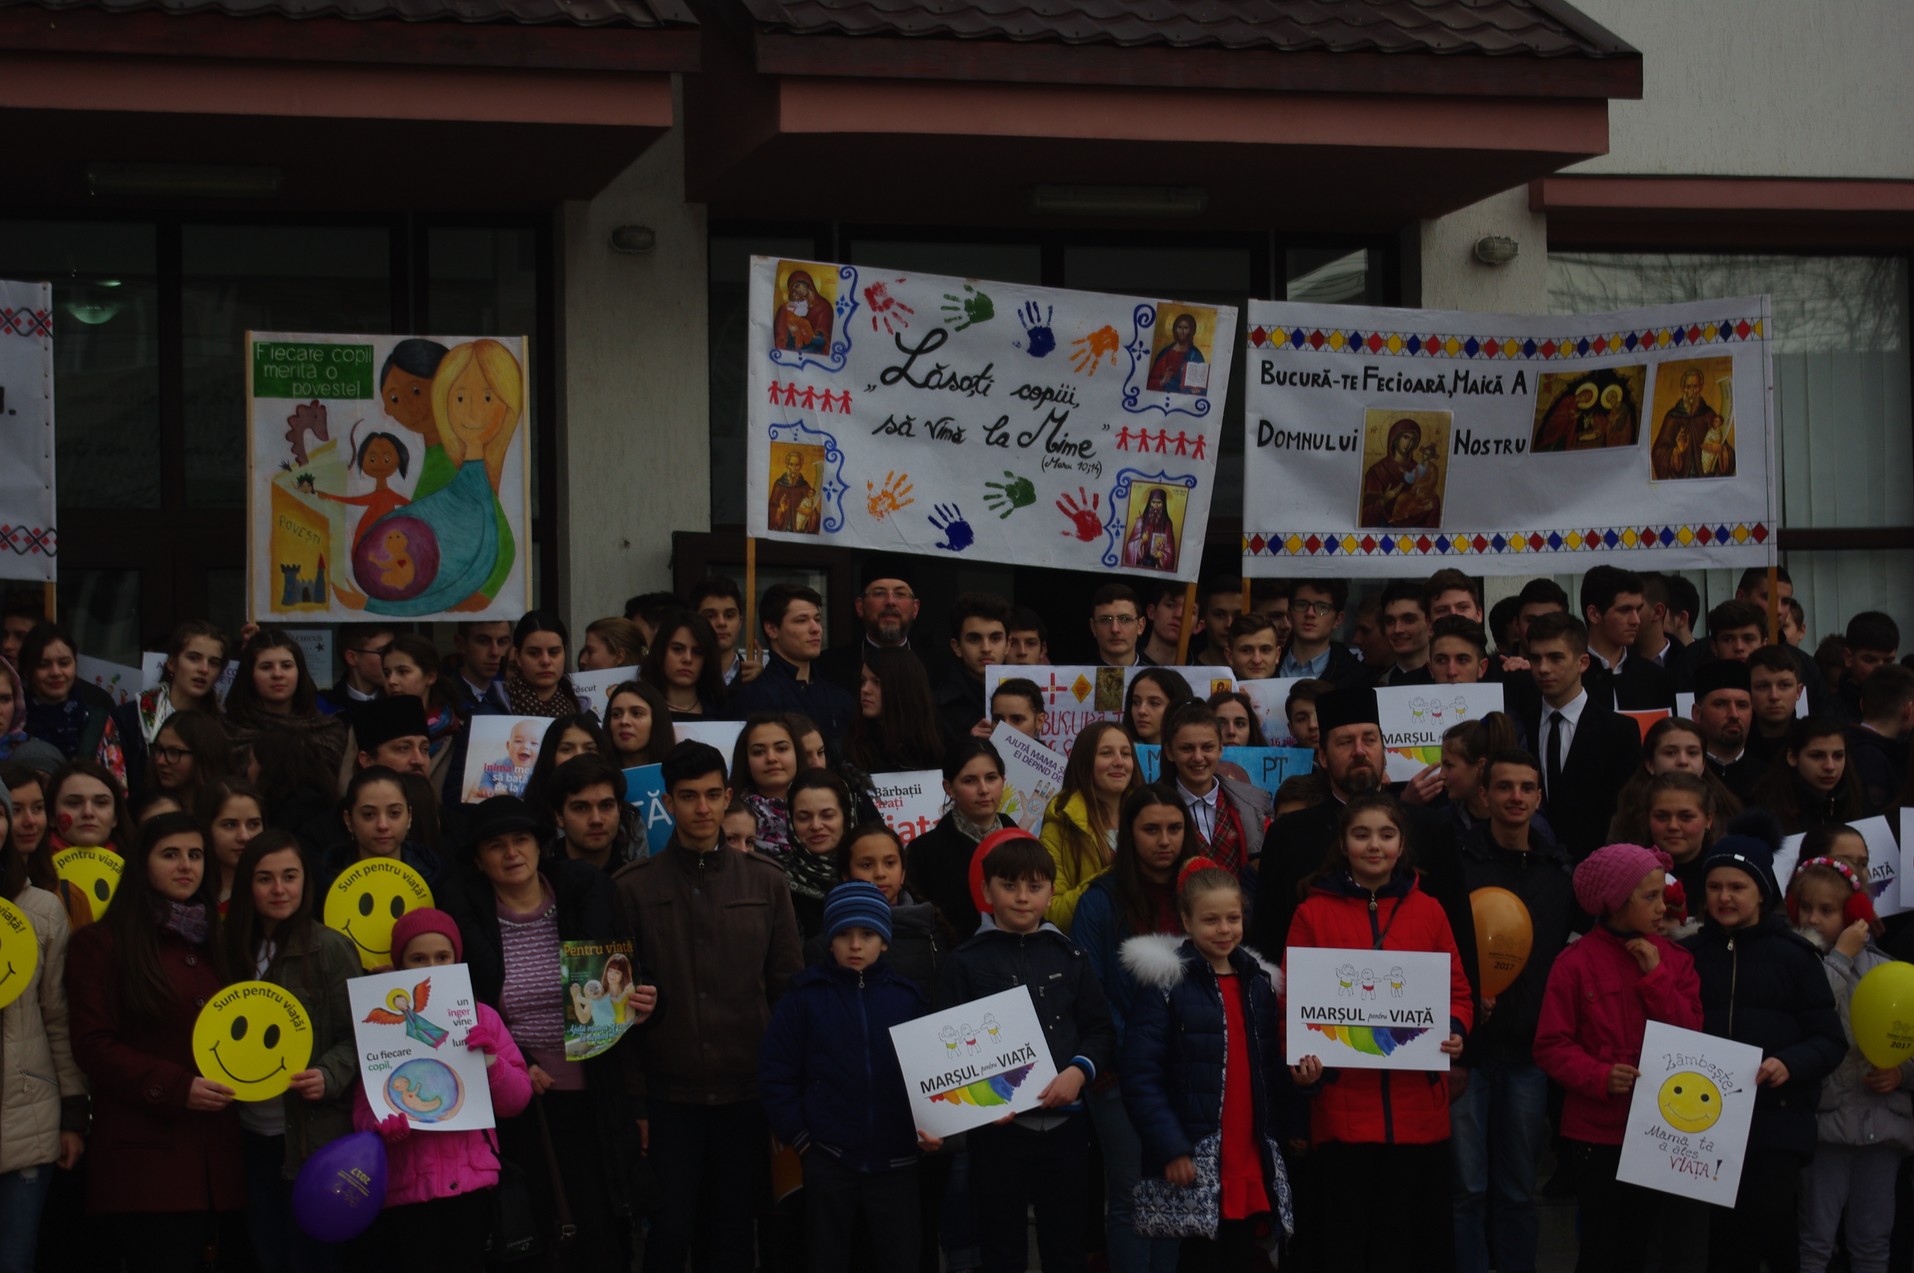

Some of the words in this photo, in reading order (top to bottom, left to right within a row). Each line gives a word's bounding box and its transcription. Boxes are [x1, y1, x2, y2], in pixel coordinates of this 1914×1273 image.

[256, 342, 324, 362] Fiecare
[326, 366, 338, 380] o
[1511, 370, 1528, 395] A
[872, 414, 916, 438] să
[983, 415, 1009, 448] la
[1454, 429, 1527, 456] NOSTRU
[1381, 731, 1436, 746] MARȘUL
[1005, 735, 1031, 753] AJUTĂ
[1030, 748, 1058, 770] MAMA
[1021, 757, 1052, 777] DEPIND
[57, 850, 96, 869] pentru
[1868, 862, 1895, 879] IAȚĂ
[338, 869, 362, 892] Sunt
[362, 863, 401, 877] pentru
[402, 871, 427, 899] viață!
[564, 943, 604, 957] Pentru
[213, 990, 240, 1012] Sunt
[242, 987, 283, 1003] pentru
[283, 1001, 306, 1032] viață!
[457, 999, 469, 1007] un
[453, 1018, 472, 1027] vine
[1301, 1006, 1366, 1024] MARȘUL
[1389, 1007, 1434, 1027] VIAȚĂ
[366, 1053, 379, 1062] Cu
[380, 1048, 412, 1060] fiecare
[920, 1065, 980, 1094] MARȘUL
[997, 1042, 1036, 1068] VIAȚĂ
[1644, 1125, 1689, 1147] Mama
[1699, 1136, 1715, 1152] ta
[1658, 1141, 1668, 1152] a
[1672, 1144, 1699, 1159] ales
